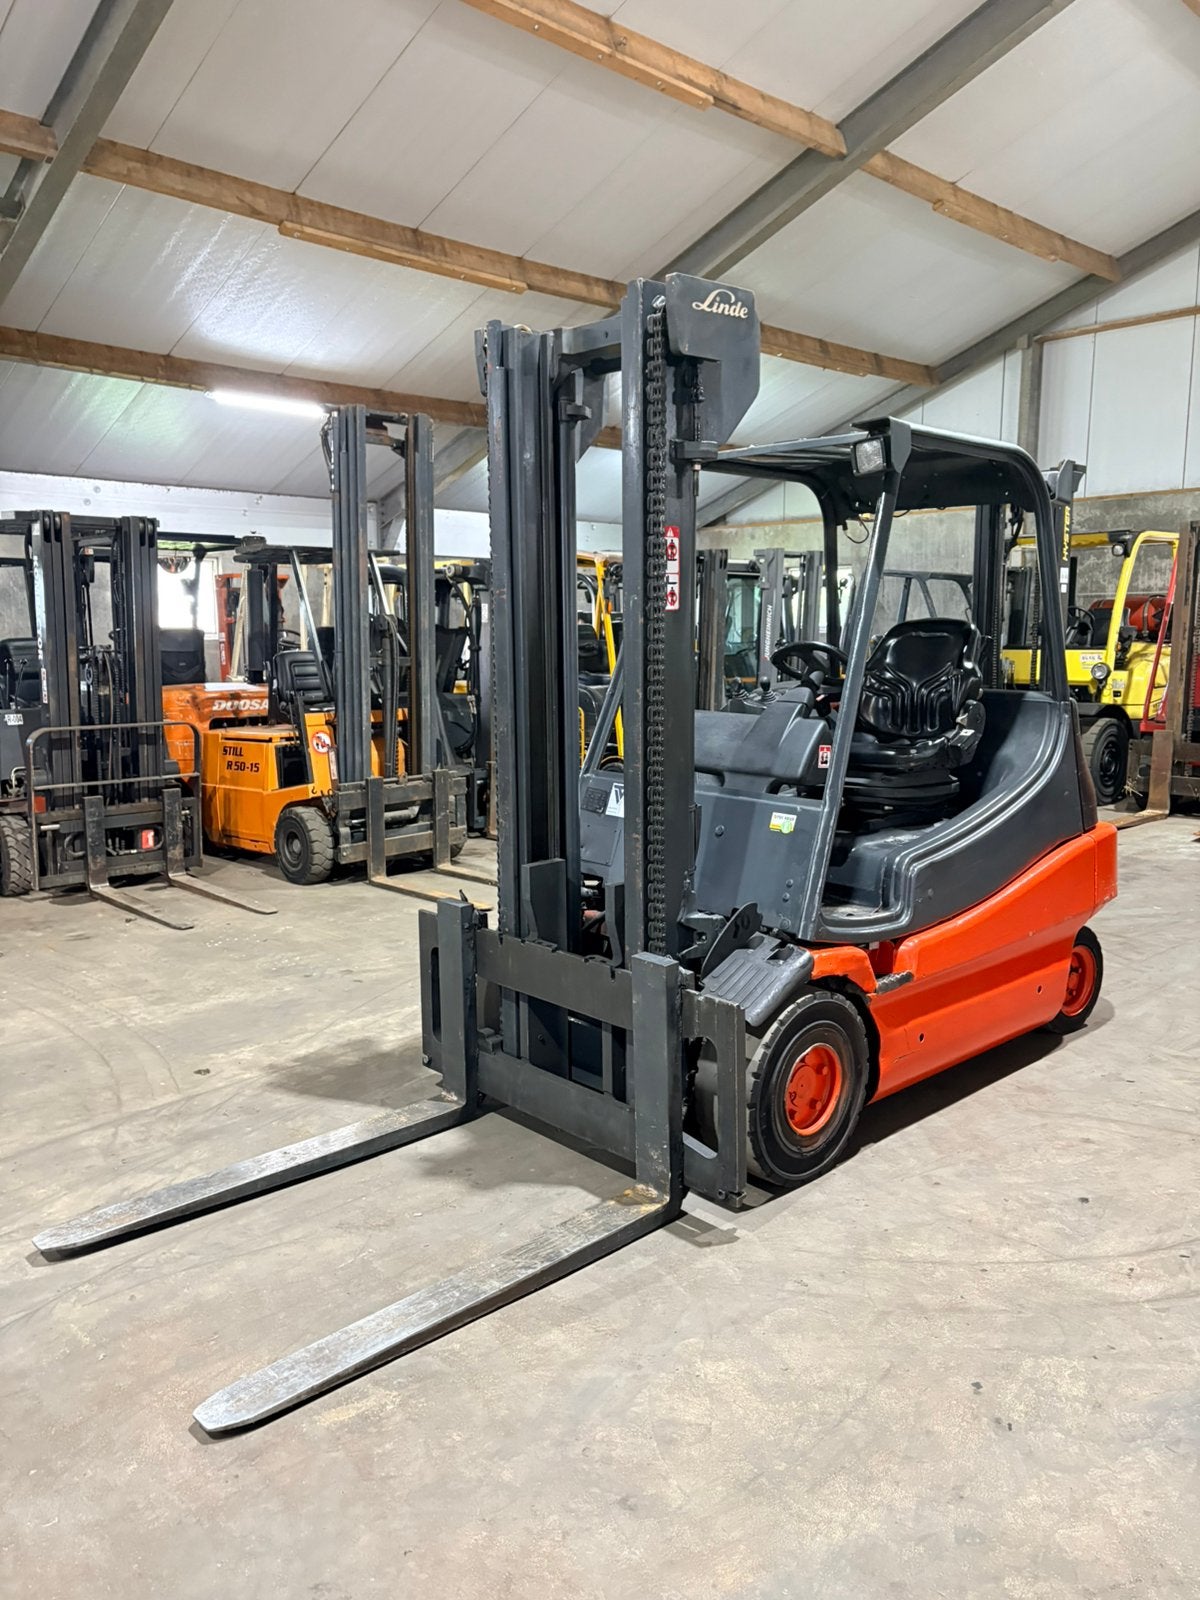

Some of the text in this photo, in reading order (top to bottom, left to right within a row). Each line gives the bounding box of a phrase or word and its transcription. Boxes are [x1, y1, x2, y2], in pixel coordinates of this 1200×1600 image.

[692, 288, 749, 319] Linde
[1062, 506, 1070, 561] HYSTER
[764, 605, 772, 661] JUNGHEINRICH
[222, 745, 244, 757] STILL
